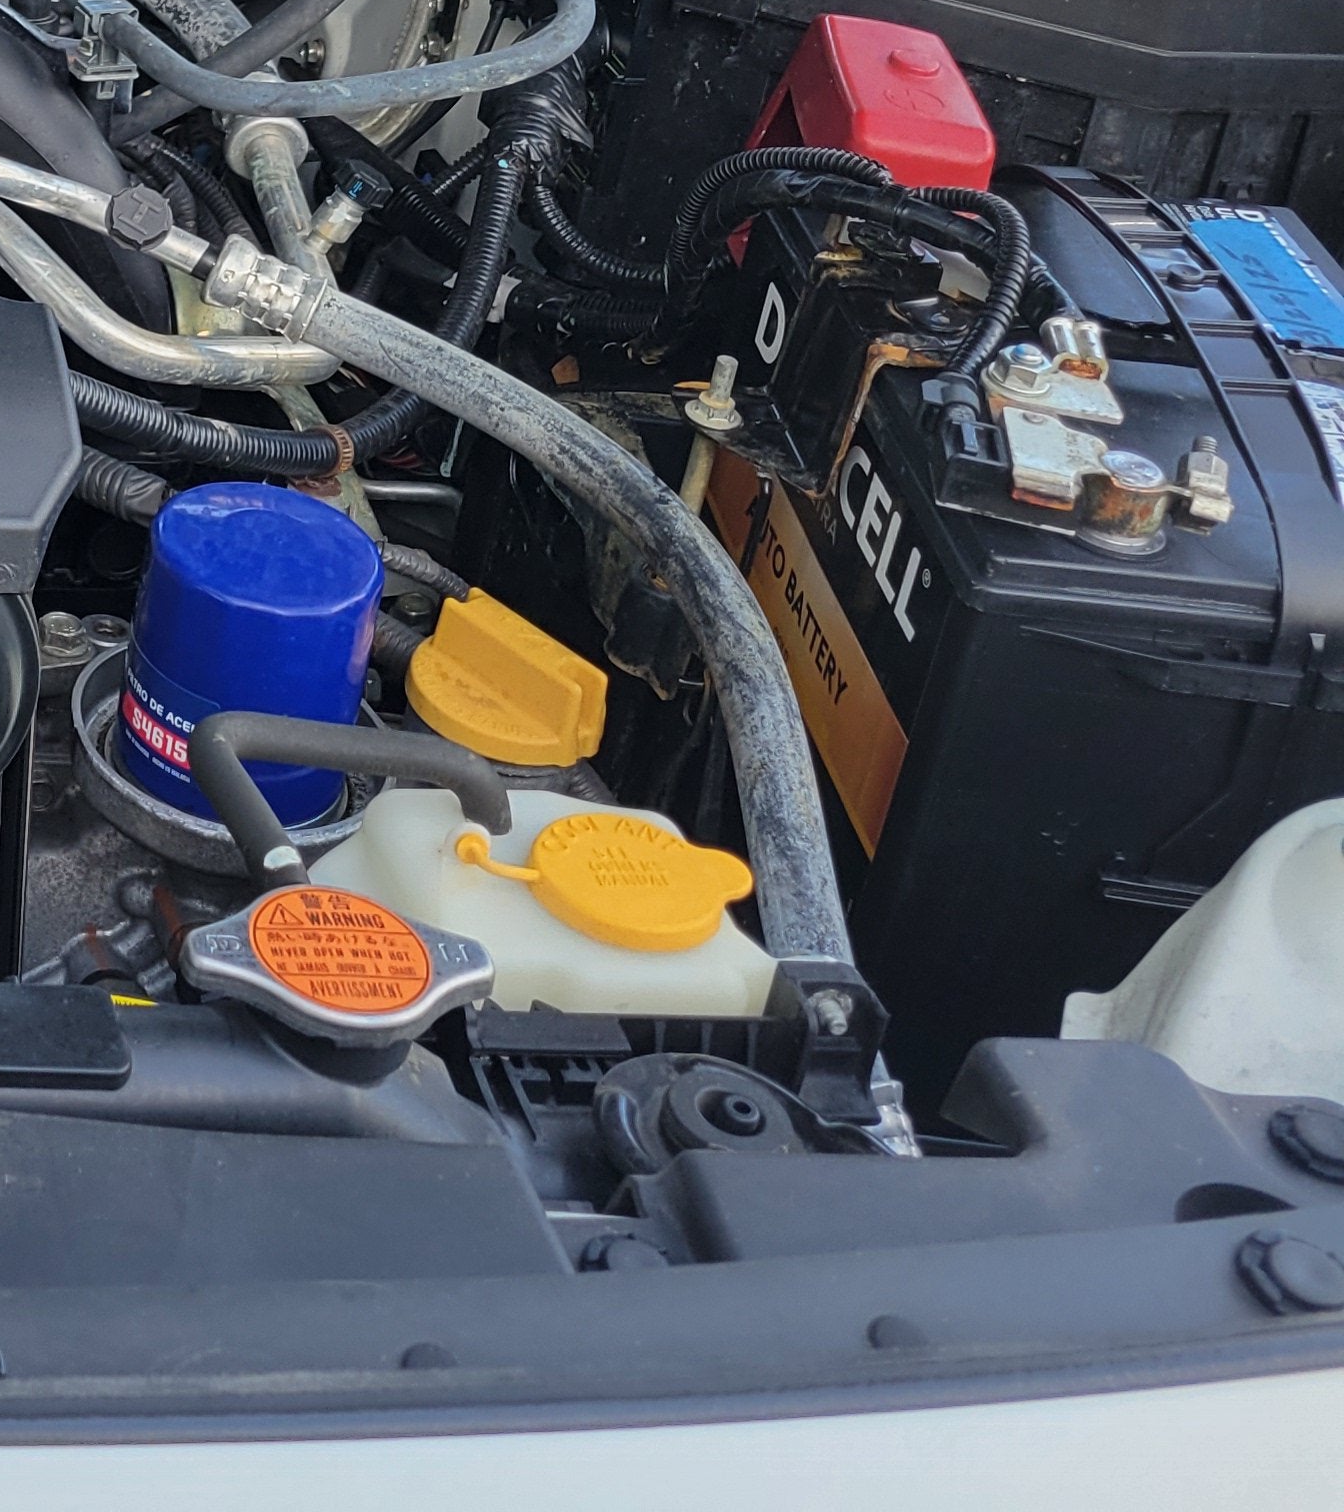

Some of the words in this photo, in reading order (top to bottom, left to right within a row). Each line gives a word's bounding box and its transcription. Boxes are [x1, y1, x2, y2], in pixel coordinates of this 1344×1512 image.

[784, 566, 848, 706] BATTERY
[149, 697, 165, 717] DE
[132, 706, 189, 763] S4615
[542, 816, 685, 852] COOLANT
[305, 911, 385, 929] WARNING
[270, 946, 307, 958] NEVER
[313, 947, 345, 958] OPEN
[350, 948, 383, 960] WHEN
[309, 979, 404, 999] AVERTISSMENT
